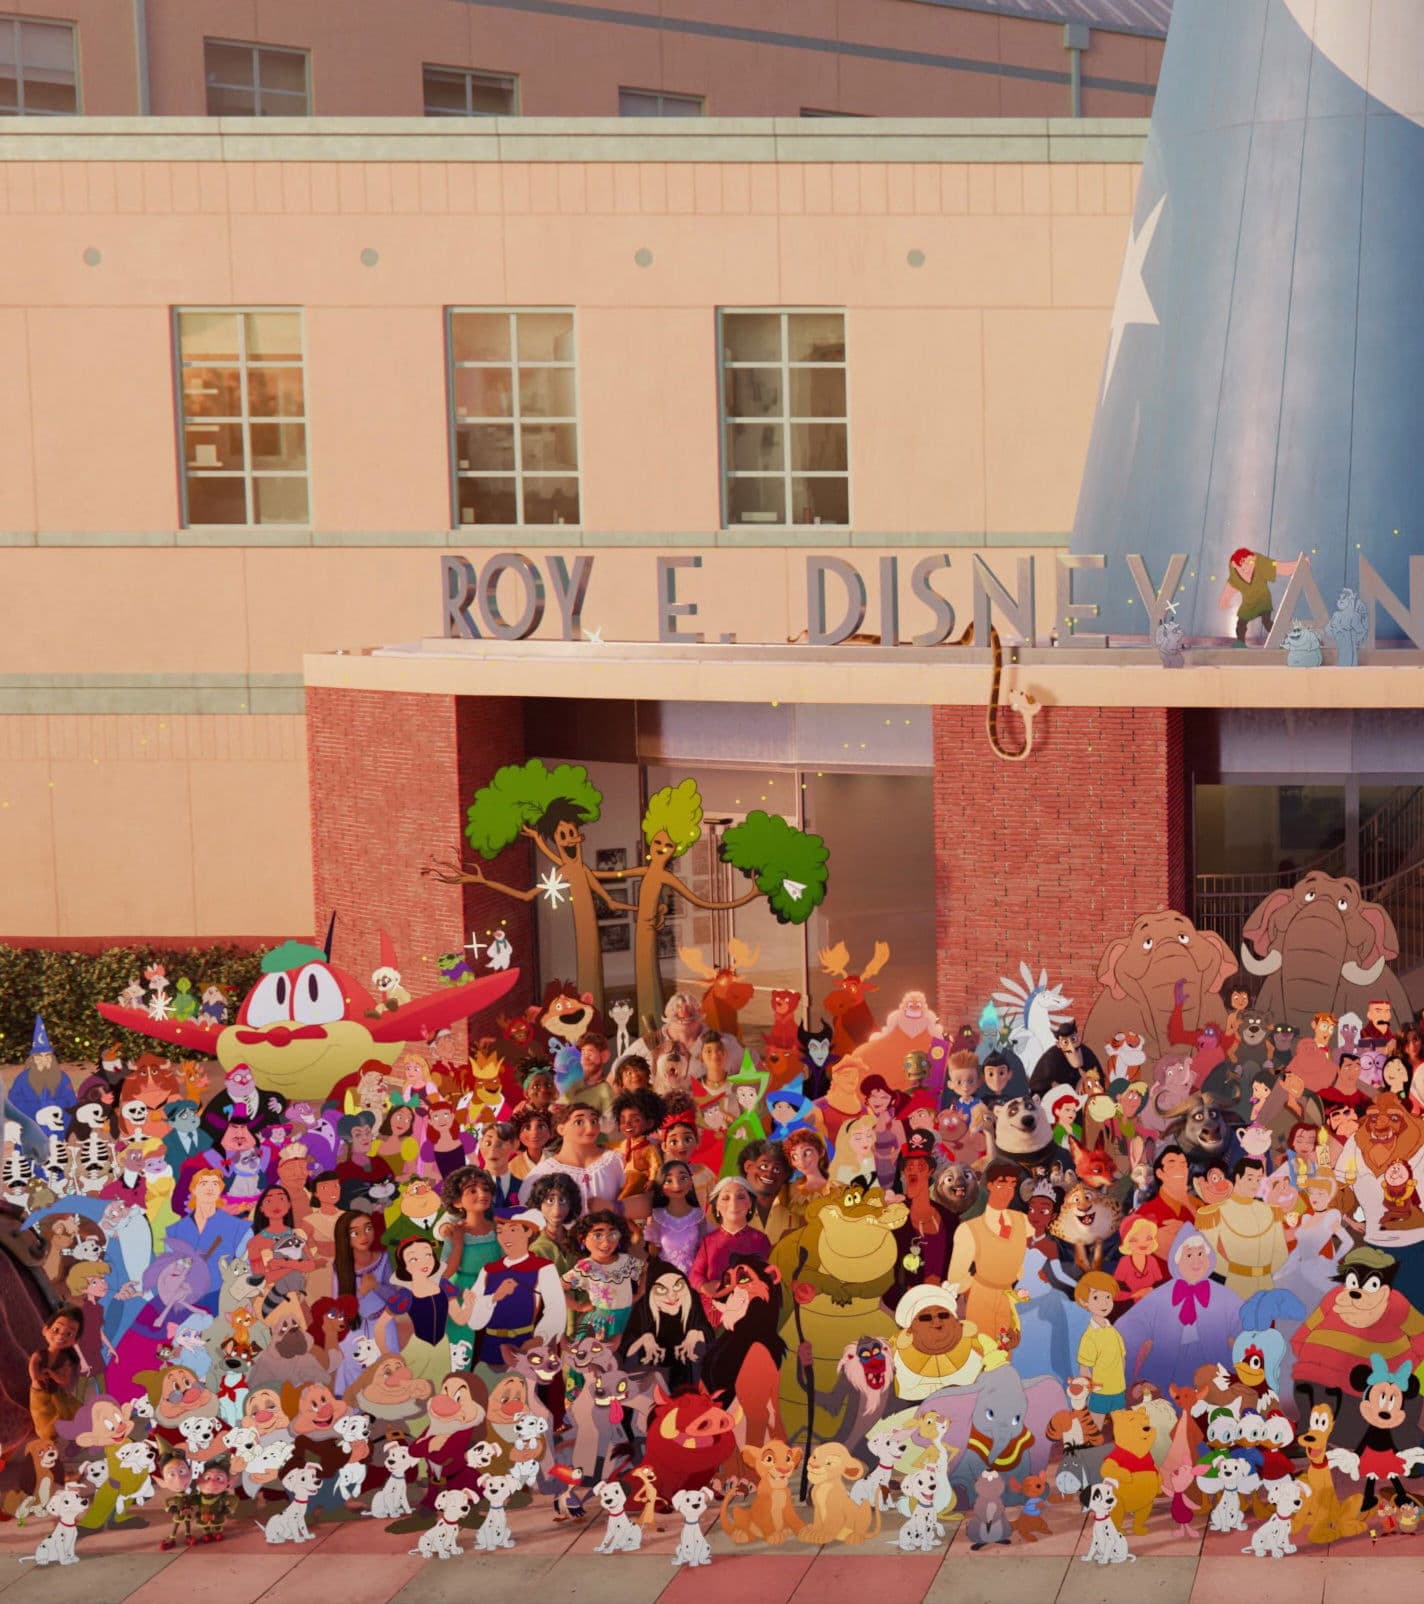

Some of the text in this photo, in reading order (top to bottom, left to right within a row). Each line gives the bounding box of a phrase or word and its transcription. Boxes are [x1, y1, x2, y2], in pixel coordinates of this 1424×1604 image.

[440, 553, 595, 641] ROY
[657, 556, 736, 643] E.
[806, 554, 1188, 649] DISNEY
